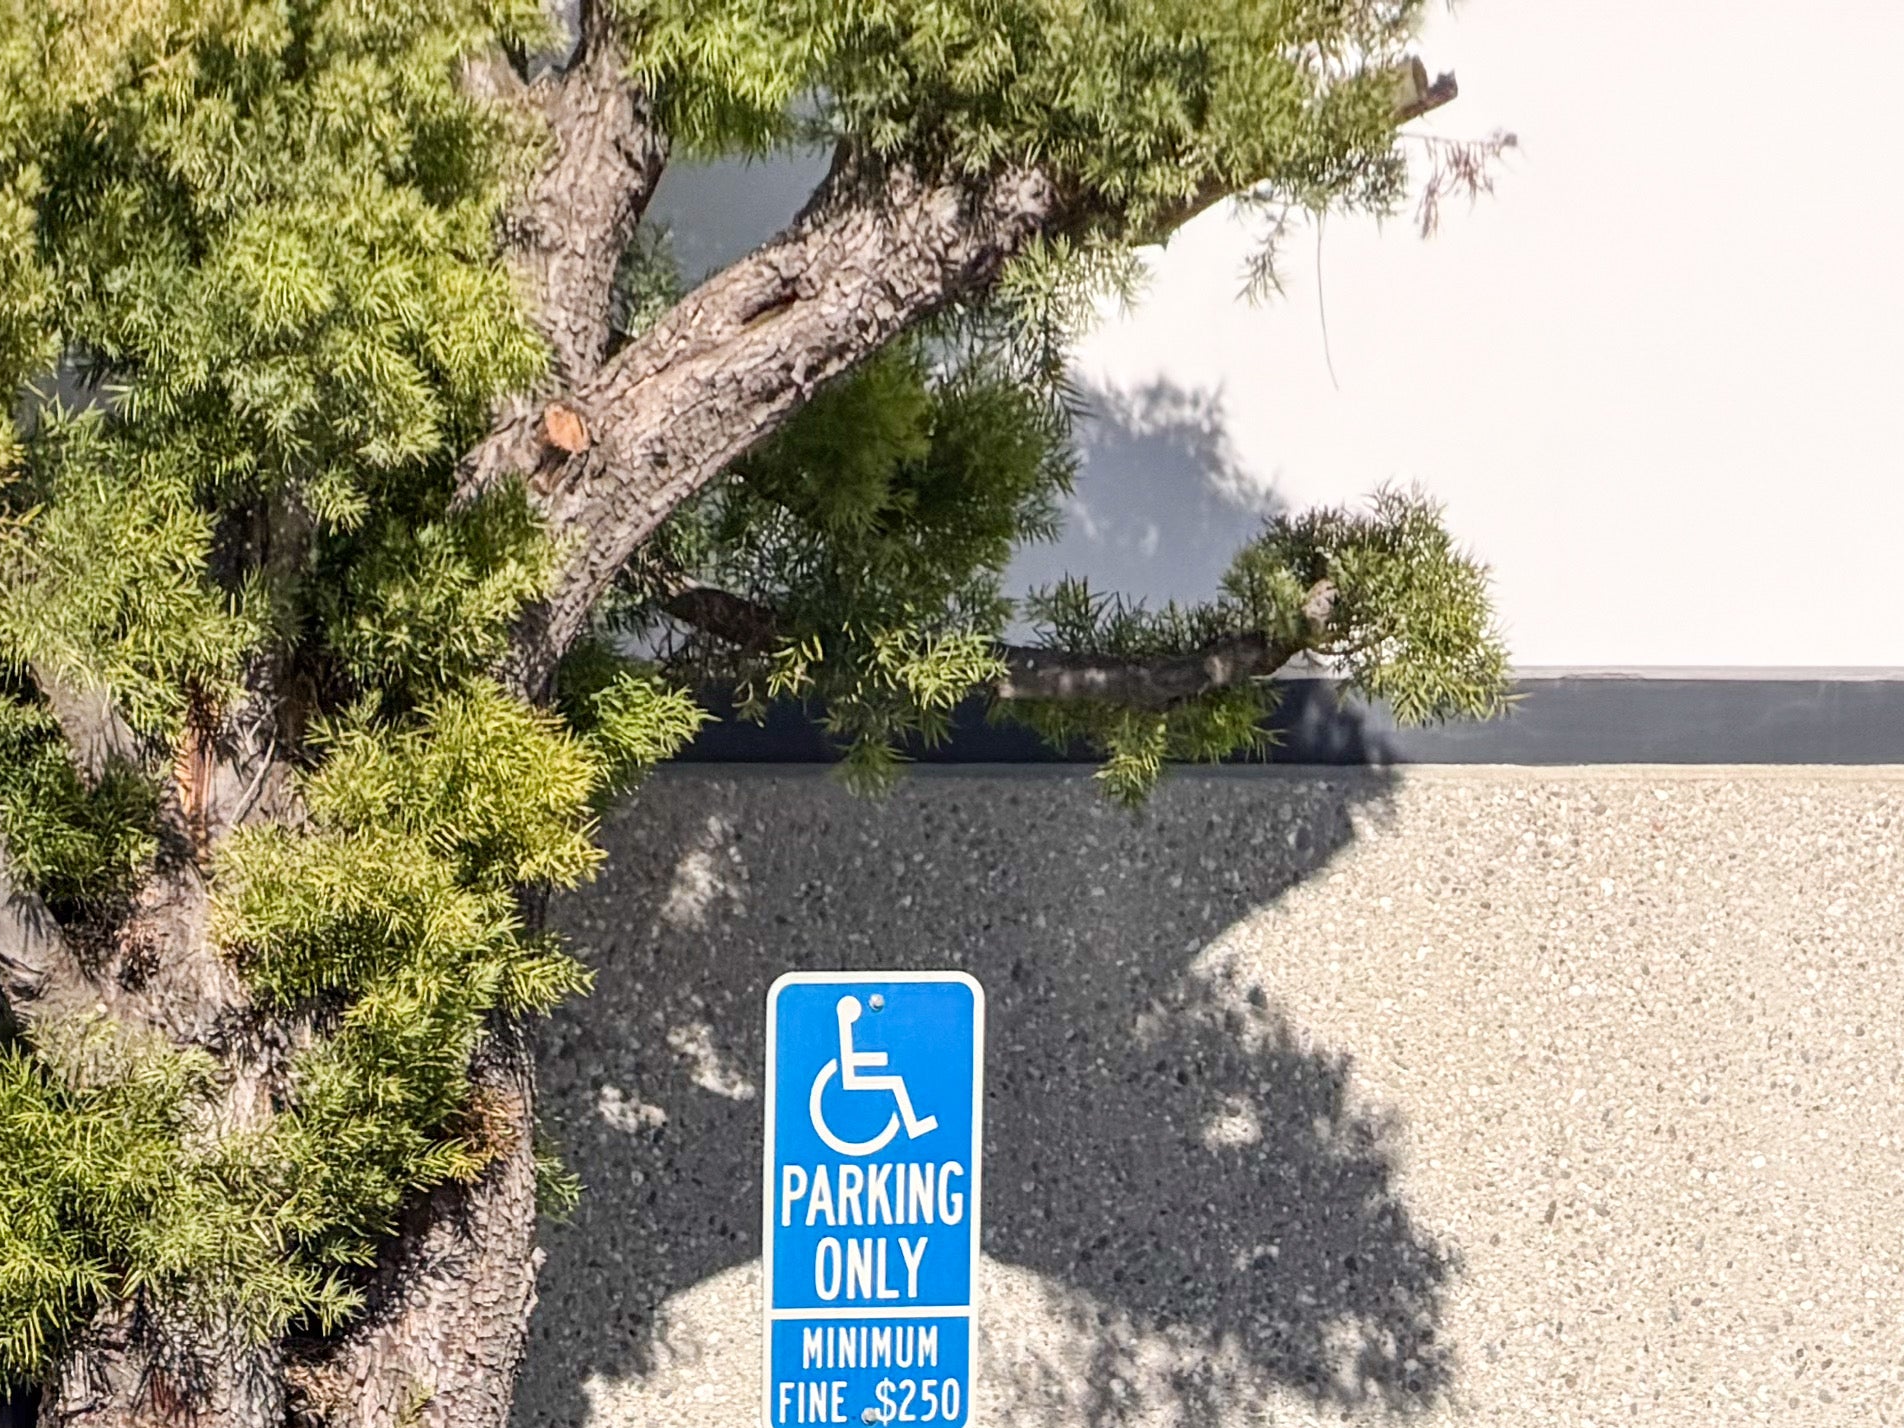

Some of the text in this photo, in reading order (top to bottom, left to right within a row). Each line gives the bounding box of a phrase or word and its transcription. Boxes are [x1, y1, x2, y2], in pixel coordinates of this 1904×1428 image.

[781, 1161, 964, 1227] PARKING
[815, 1236, 929, 1301] ONLY
[802, 1325, 938, 1370] MINIMUM
[779, 1376, 961, 1427] FINE $250
